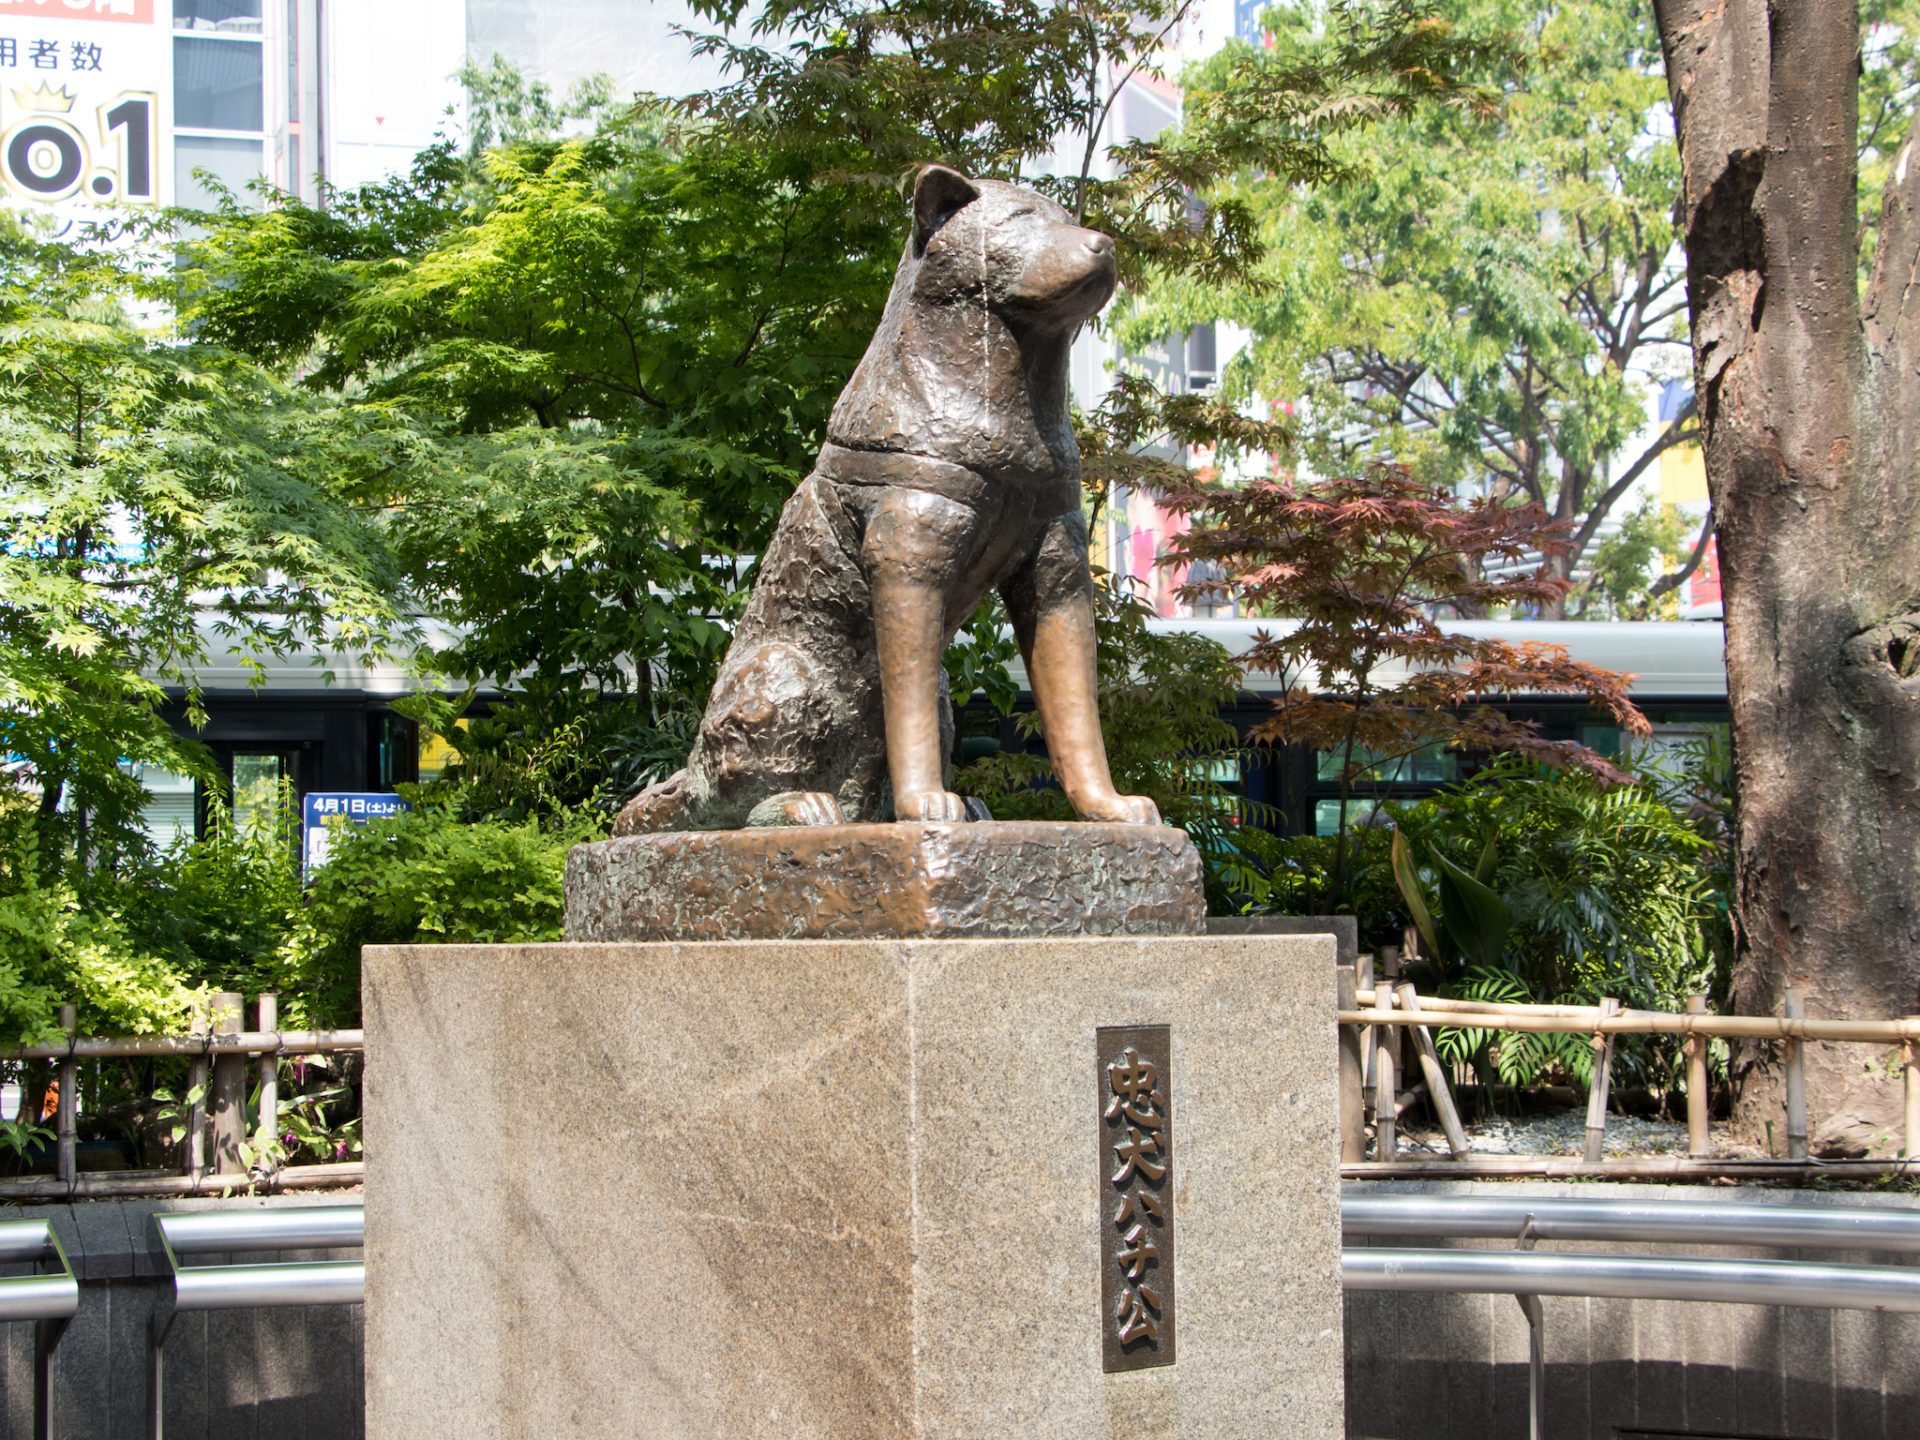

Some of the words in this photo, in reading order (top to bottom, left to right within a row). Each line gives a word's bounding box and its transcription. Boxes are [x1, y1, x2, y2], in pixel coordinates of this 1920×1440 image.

[1104, 1047, 1166, 1346] 忠犬ハチ公
